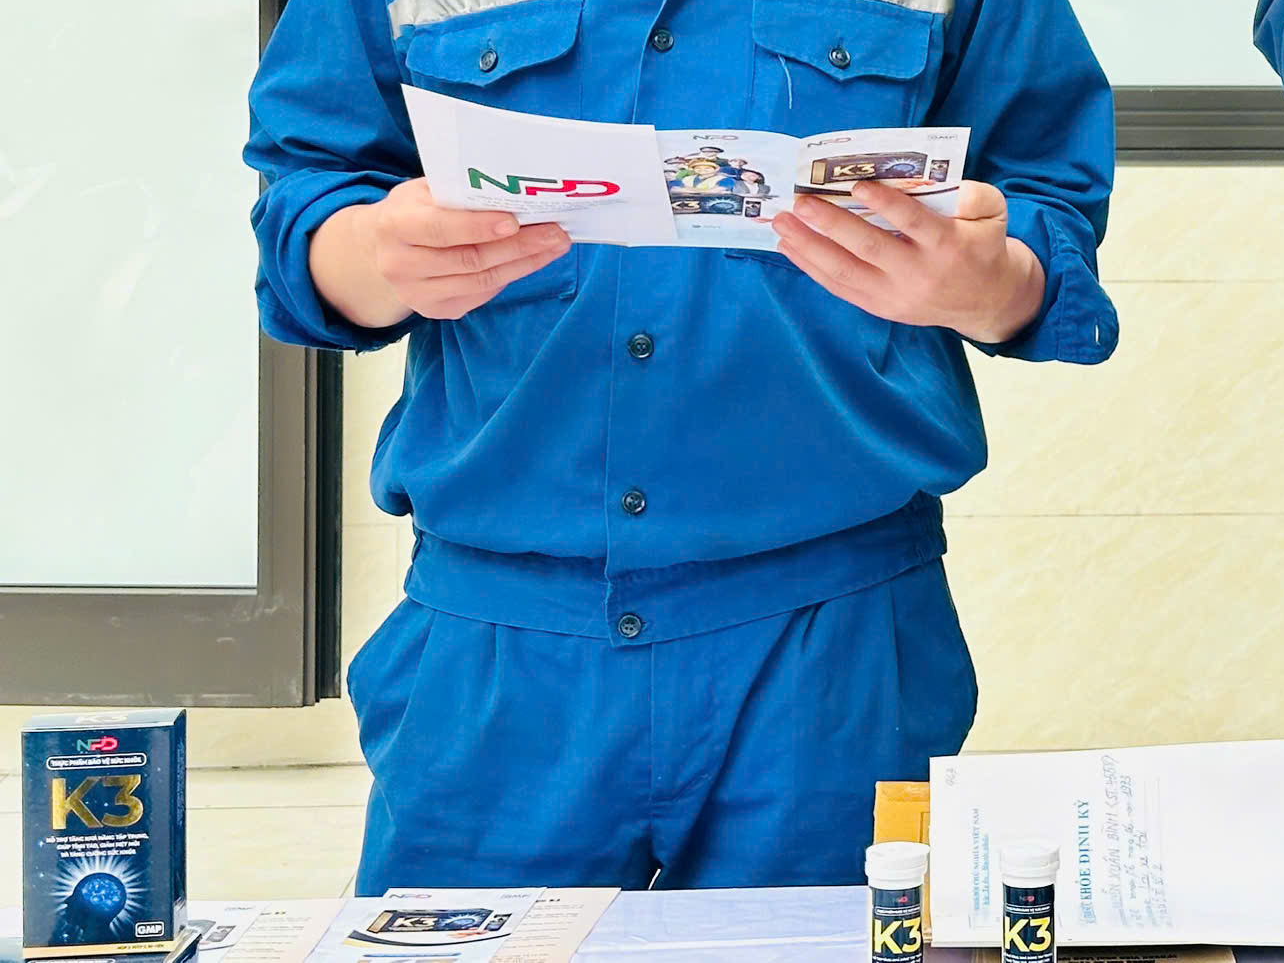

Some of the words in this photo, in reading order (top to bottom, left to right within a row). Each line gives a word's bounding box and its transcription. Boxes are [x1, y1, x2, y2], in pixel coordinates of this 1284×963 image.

[833, 163, 876, 178] K3
[467, 167, 620, 197] NPD
[77, 736, 119, 751] NPD
[52, 774, 144, 830] K3
[137, 925, 163, 935] GMP
[394, 917, 439, 927] K3
[874, 918, 921, 954] K3
[1004, 916, 1052, 953] K3
